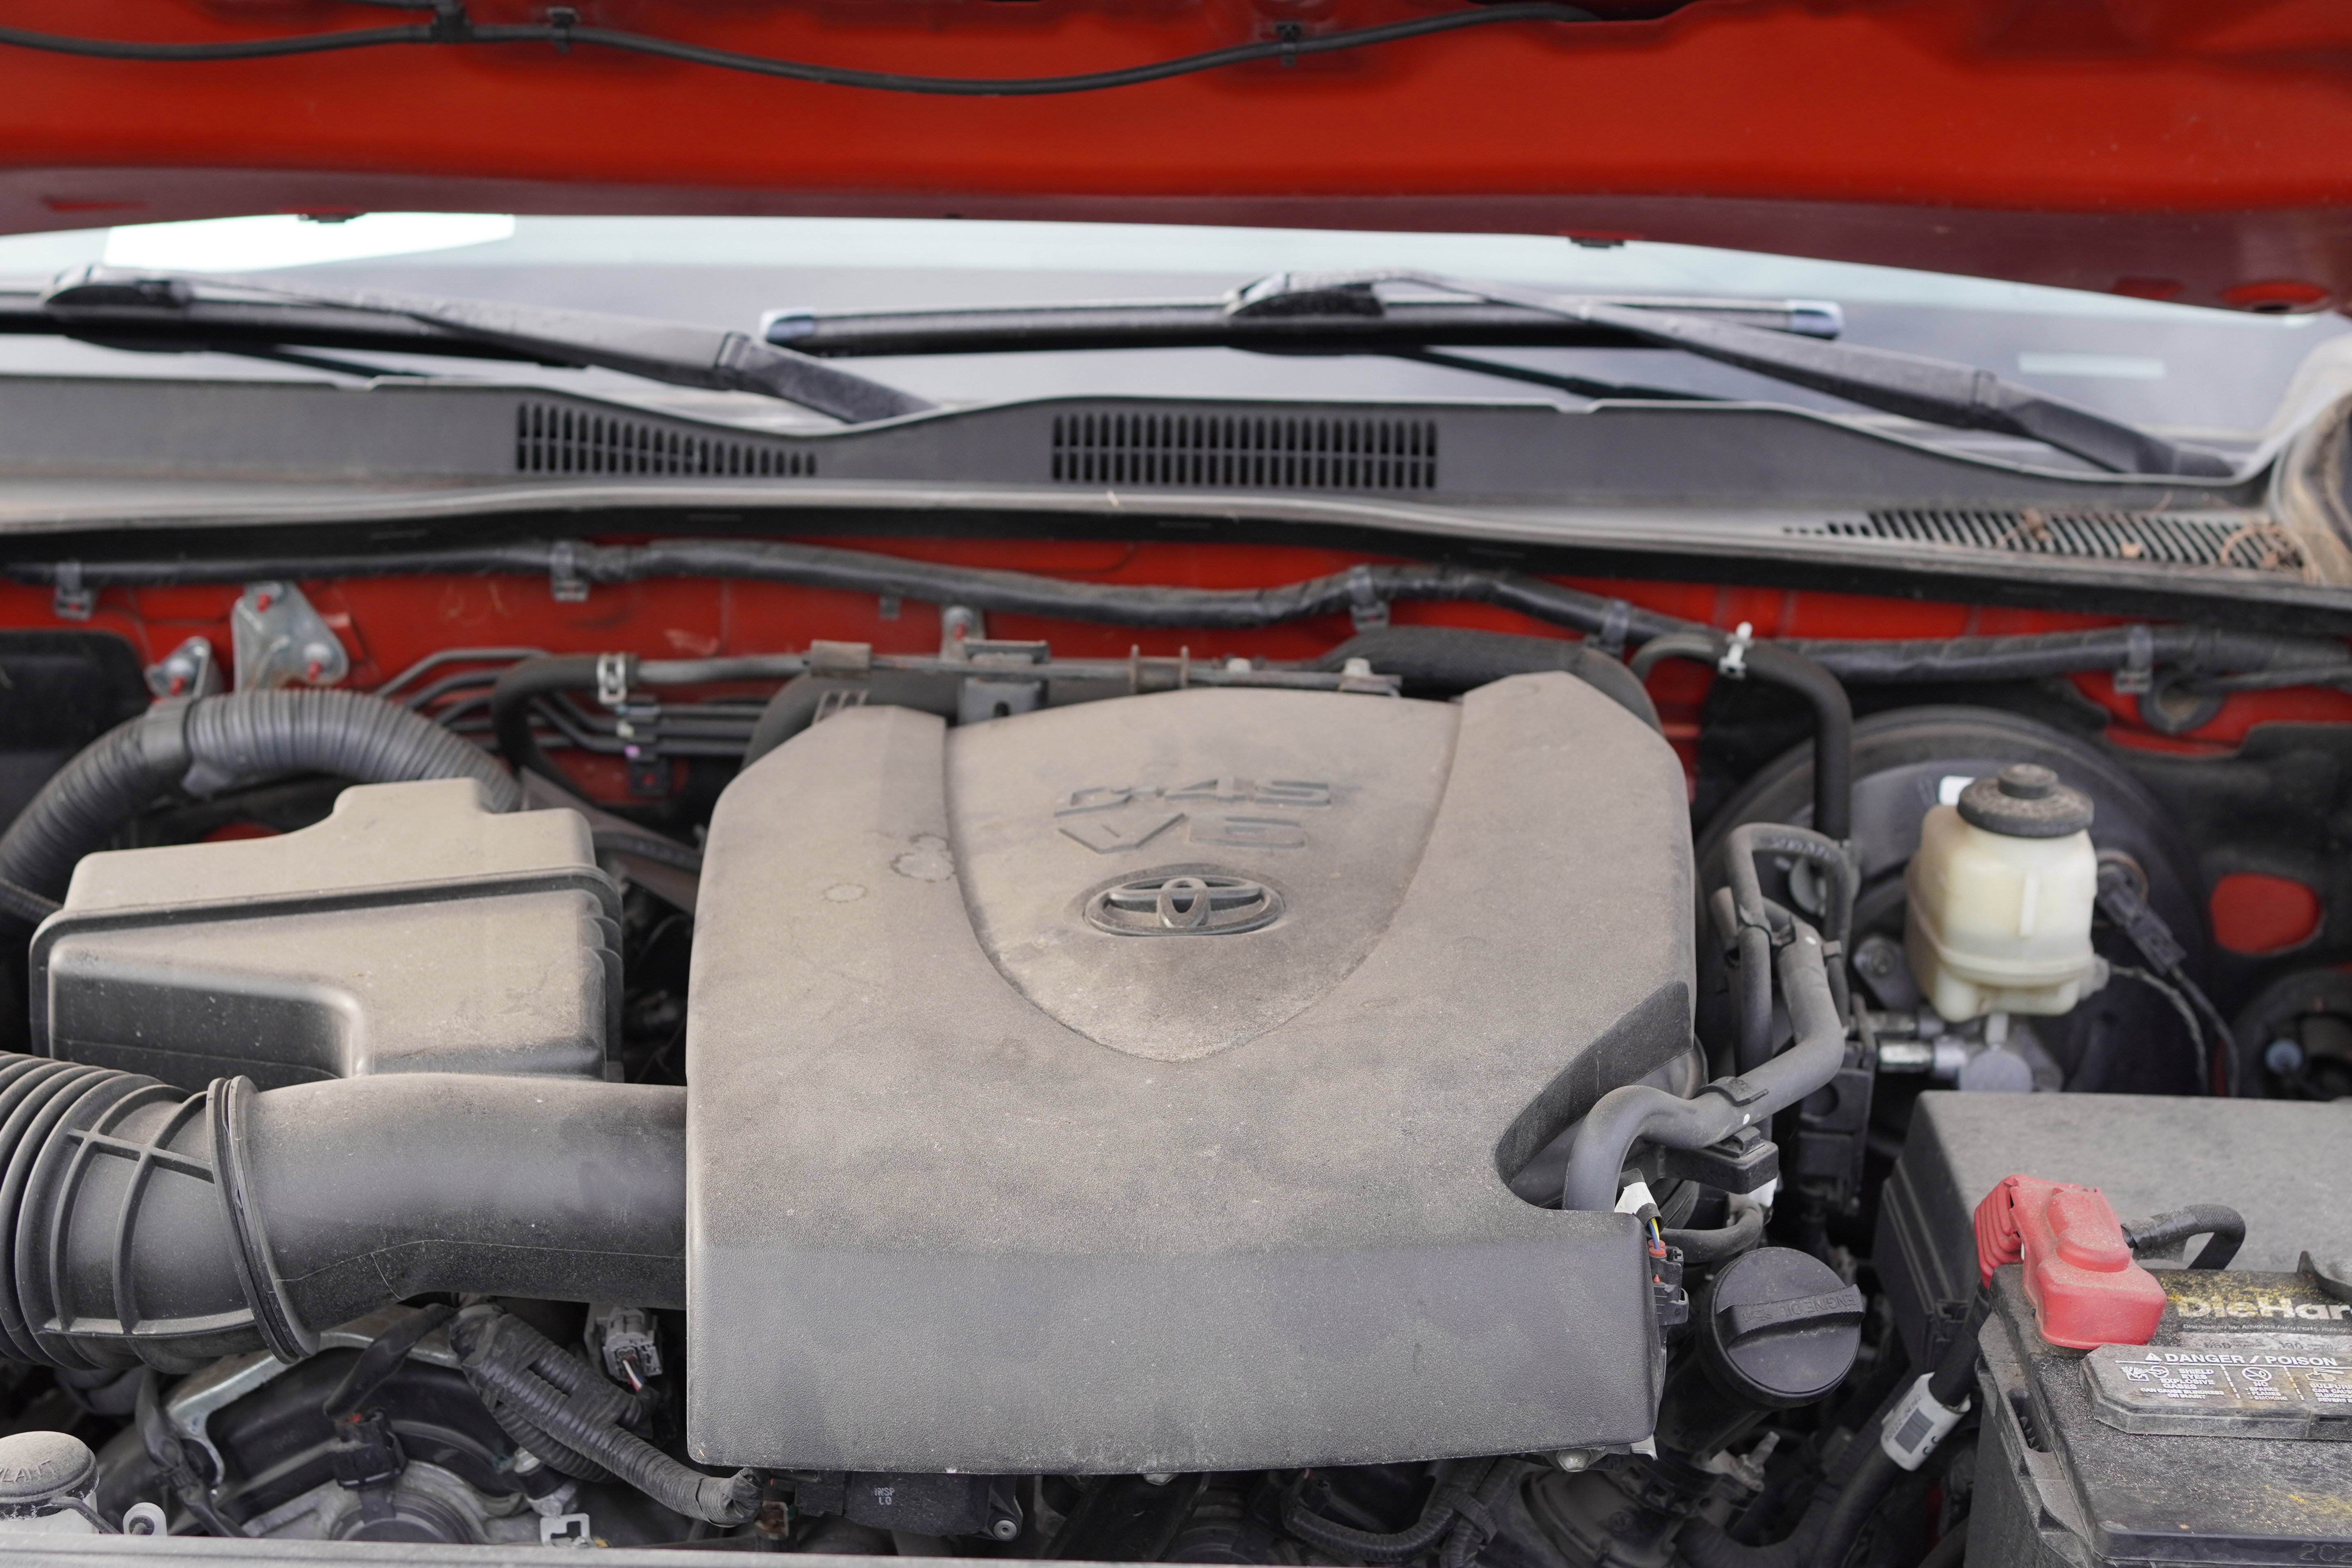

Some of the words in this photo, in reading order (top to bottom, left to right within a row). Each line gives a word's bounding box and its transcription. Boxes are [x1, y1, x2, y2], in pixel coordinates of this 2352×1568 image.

[1804, 1293, 1856, 1313] ENGINE
[2178, 1296, 2352, 1320] DieHar
[1779, 1304, 1803, 1317] OIL
[2164, 1353, 2245, 1364] DANGER
[2249, 1355, 2260, 1364] /
[2264, 1355, 2338, 1366] POISON
[0, 1459, 55, 1482] LANT
[874, 1487, 895, 1496] INSP
[879, 1496, 892, 1506] LO
